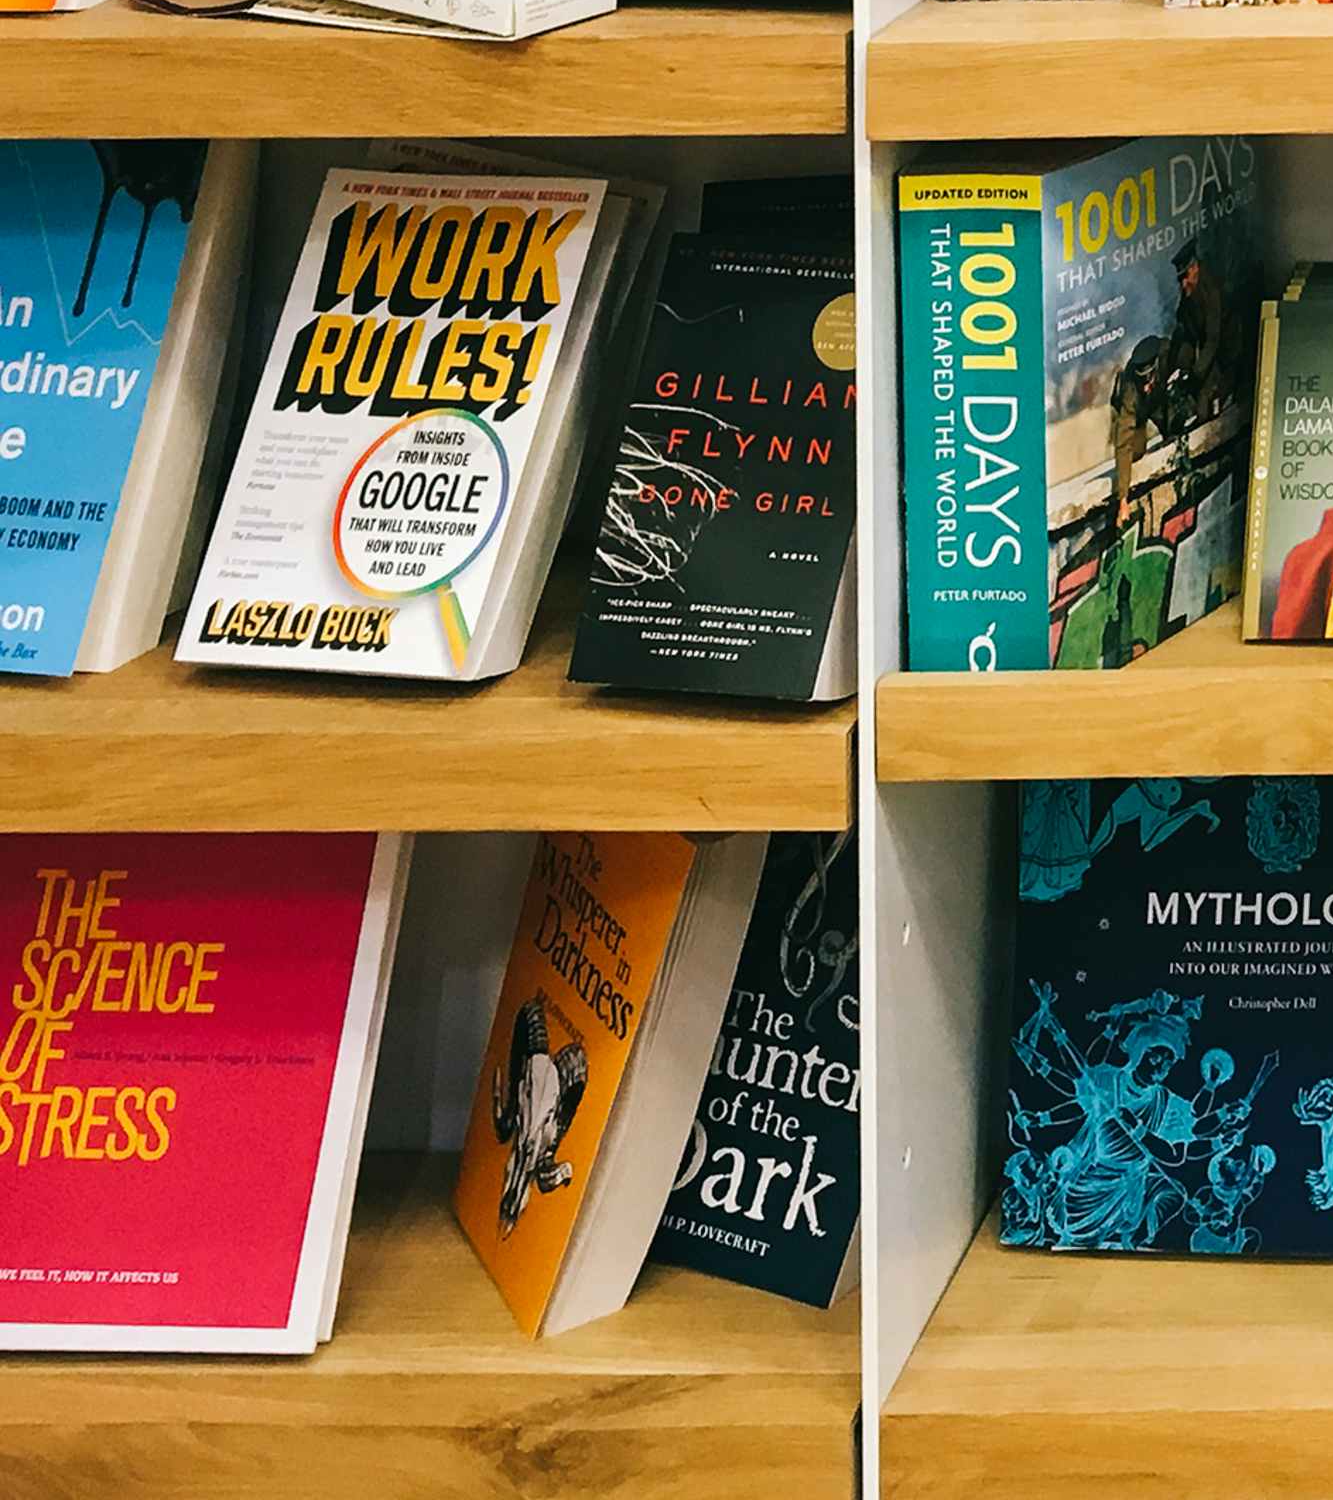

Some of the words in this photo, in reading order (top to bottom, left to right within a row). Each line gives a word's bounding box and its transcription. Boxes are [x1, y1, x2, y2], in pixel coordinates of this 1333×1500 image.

[313, 200, 587, 315] WORK
[959, 223, 1017, 371] 1001
[273, 315, 551, 420] RULES!
[1288, 377, 1320, 393] THE
[397, 450, 431, 465] FROM
[434, 451, 470, 467] INSIDE
[413, 430, 466, 446] INSIGHTS
[668, 429, 833, 465] FLYNN
[1283, 439, 1333, 457] BOOK
[962, 398, 1022, 567] DAYS
[1281, 461, 1304, 478] OF
[358, 471, 489, 513] GOOGLE
[934, 591, 968, 601] PETER
[971, 590, 1026, 601] FURTADO
[198, 598, 319, 647] LASZLO
[309, 606, 400, 652] BOCK
[34, 868, 128, 947] THE
[12, 942, 225, 1018] SCIENCE
